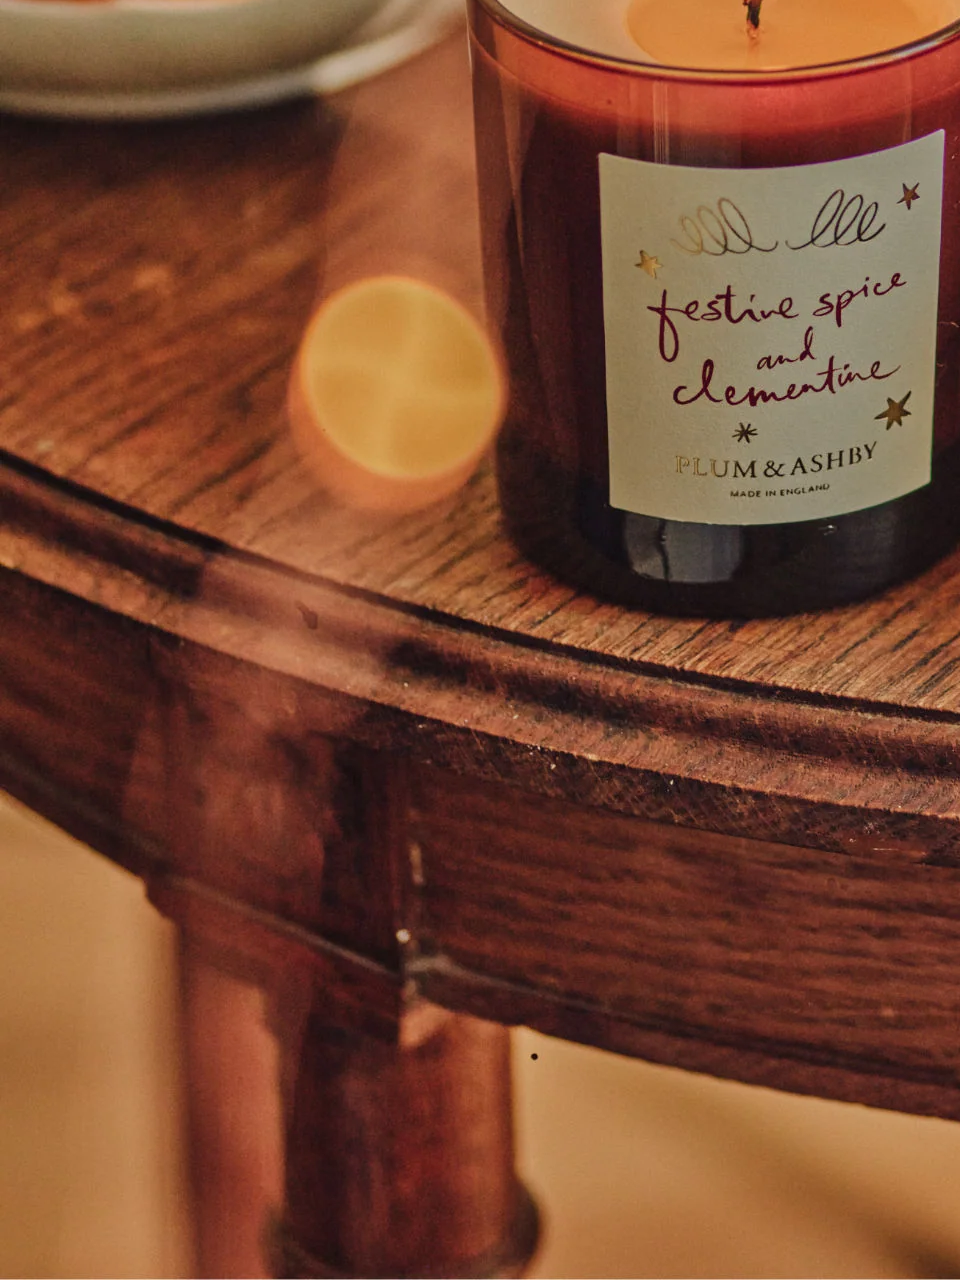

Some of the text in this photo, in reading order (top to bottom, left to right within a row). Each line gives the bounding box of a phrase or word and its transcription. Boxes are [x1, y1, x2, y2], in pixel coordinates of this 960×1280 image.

[647, 272, 907, 363] festive spice
[756, 327, 816, 370] and
[672, 355, 902, 407] clementine
[730, 483, 830, 498] MADE IN ENGLAND
